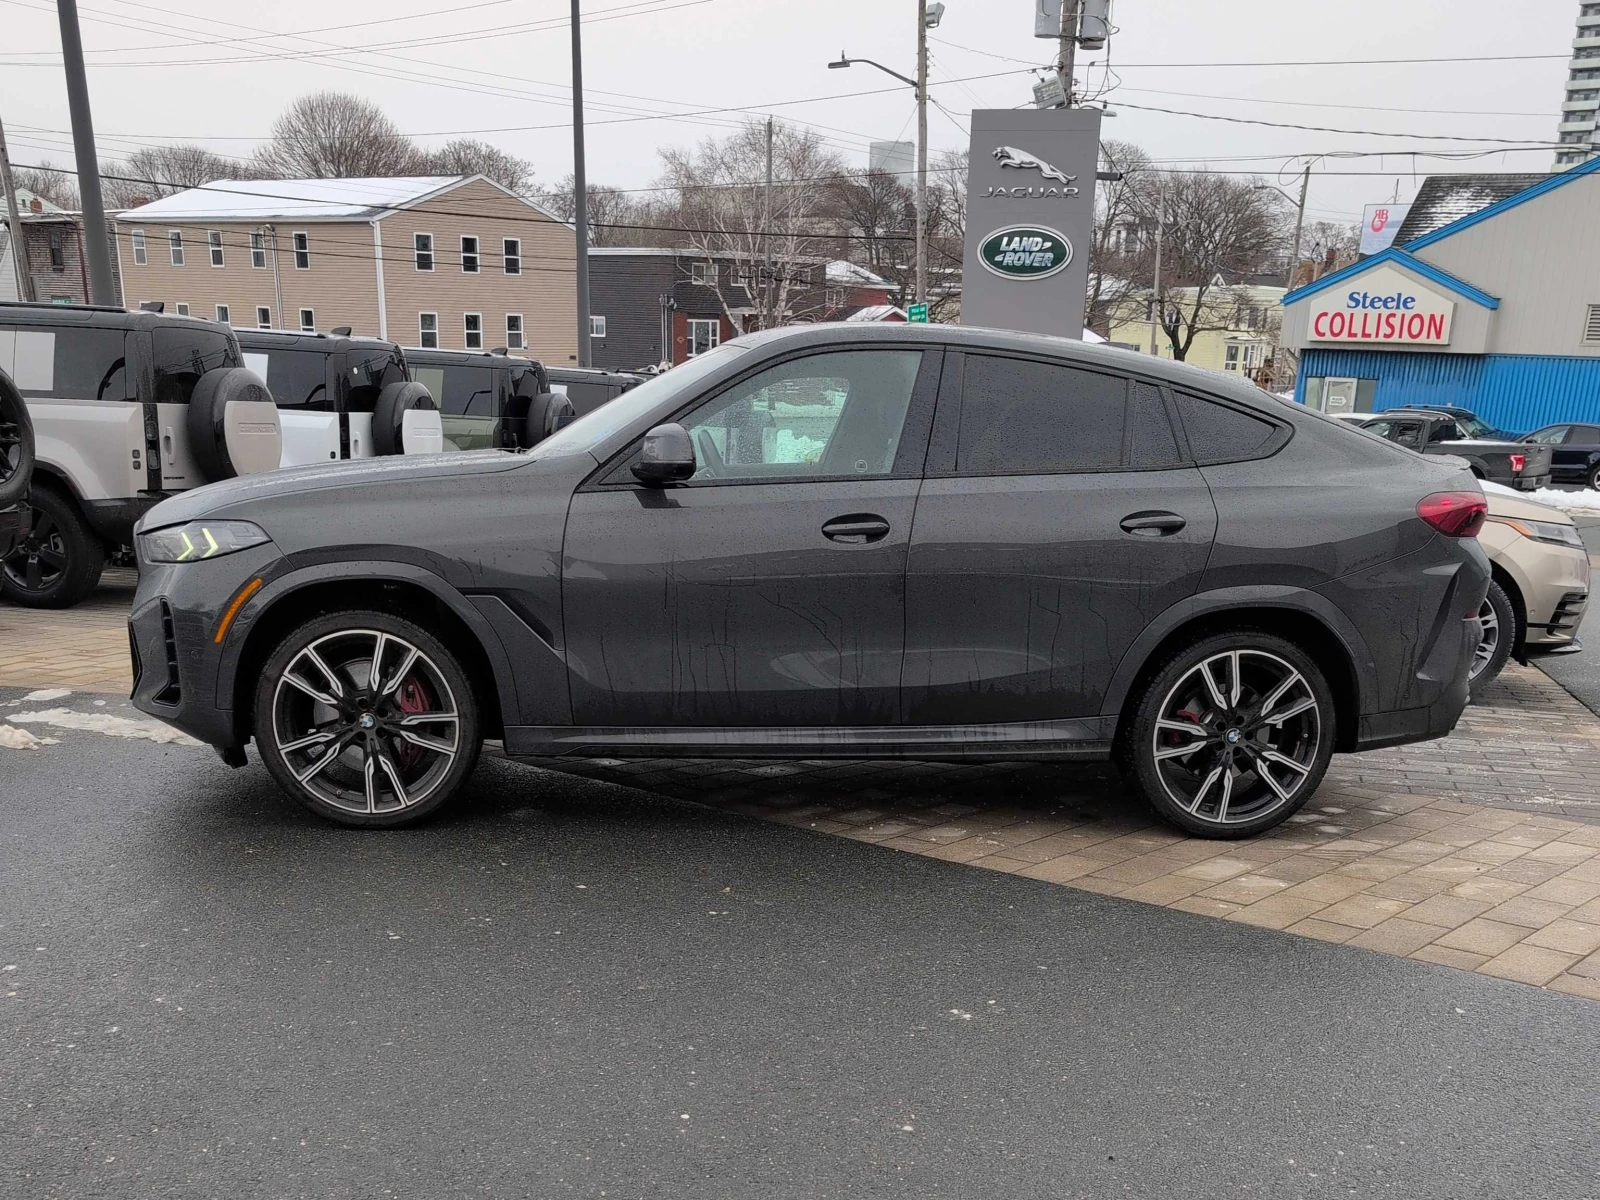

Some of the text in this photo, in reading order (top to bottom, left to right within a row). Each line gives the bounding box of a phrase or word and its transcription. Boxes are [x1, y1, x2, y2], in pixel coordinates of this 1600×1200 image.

[979, 186, 1080, 199] JAGUAR
[1000, 236, 1042, 251] LAND
[1003, 252, 1054, 267] ROVER
[1346, 291, 1416, 310] Steele
[1313, 311, 1445, 340] COLLISION
